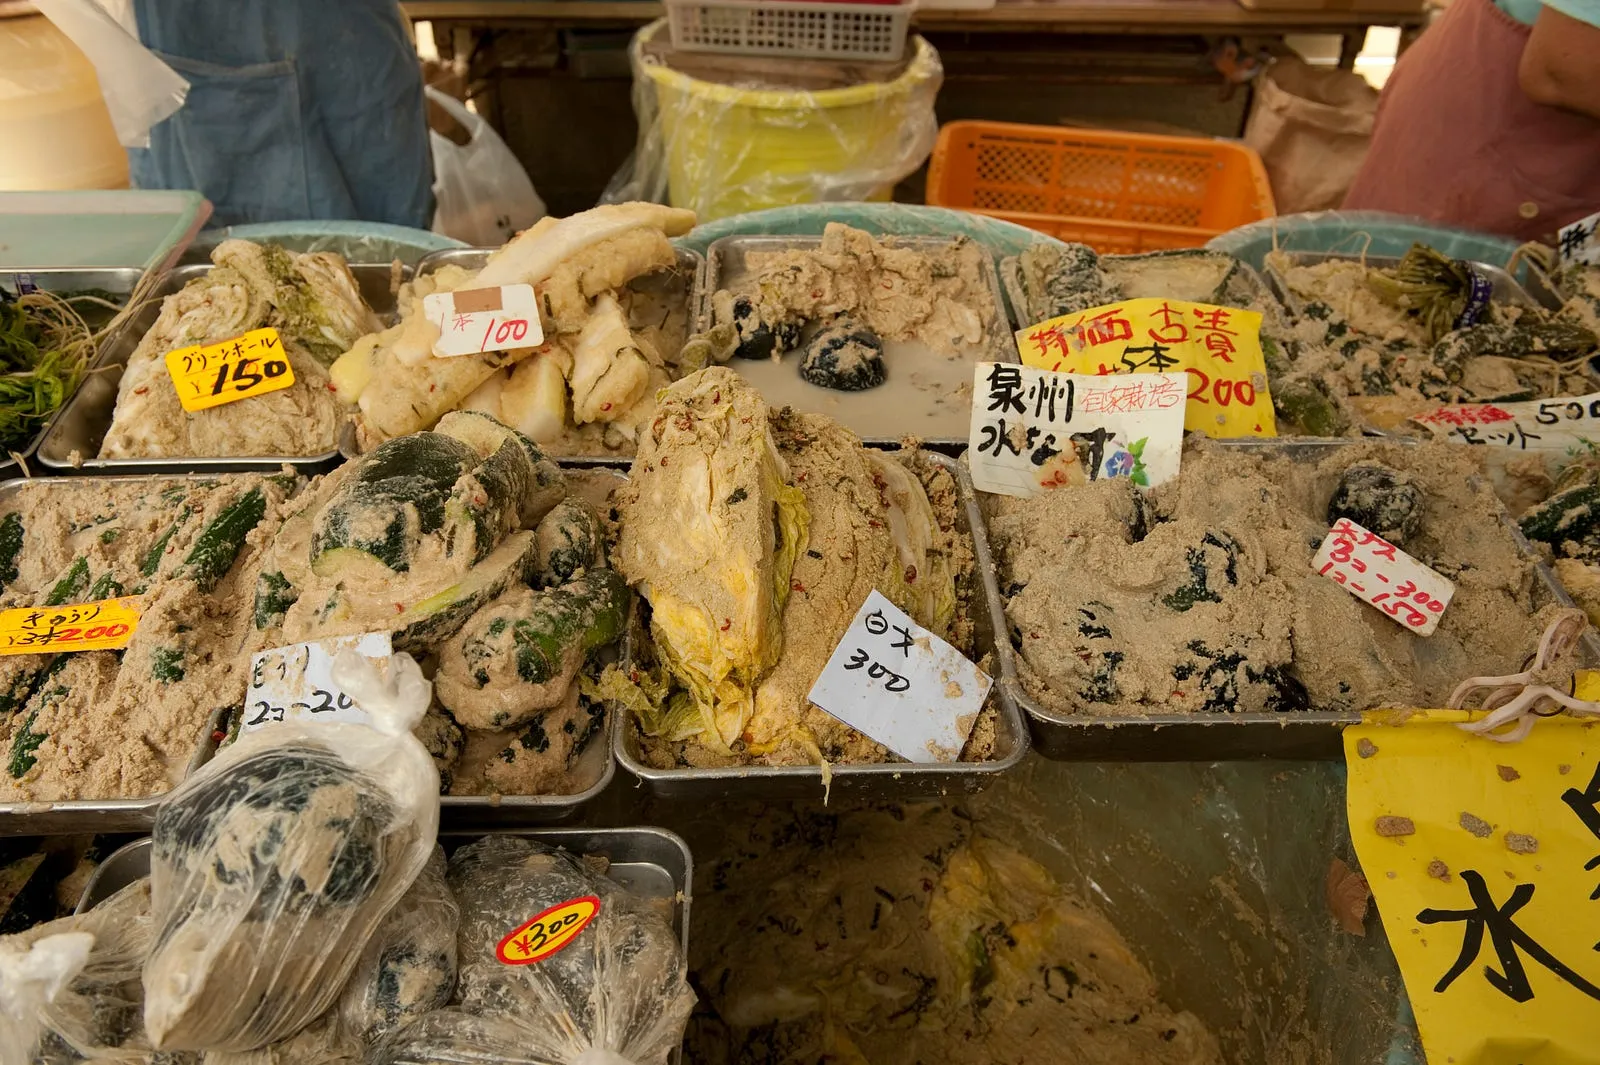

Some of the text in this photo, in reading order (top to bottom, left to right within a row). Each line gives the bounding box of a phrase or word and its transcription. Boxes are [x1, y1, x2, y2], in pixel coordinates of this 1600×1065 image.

[481, 318, 528, 352] 100
[1029, 308, 1133, 358] 特価
[183, 337, 278, 373] グリーンボール
[1120, 342, 1180, 373] 5本
[986, 363, 1183, 423] 泉州 自家栽培
[1187, 367, 1256, 406] 200
[977, 418, 1116, 482] 水なす
[1448, 422, 1541, 449] セット
[21, 605, 101, 630] きゅうり
[843, 648, 910, 692] 300
[512, 912, 579, 957] ¥300
[1416, 870, 1600, 1003] 水
